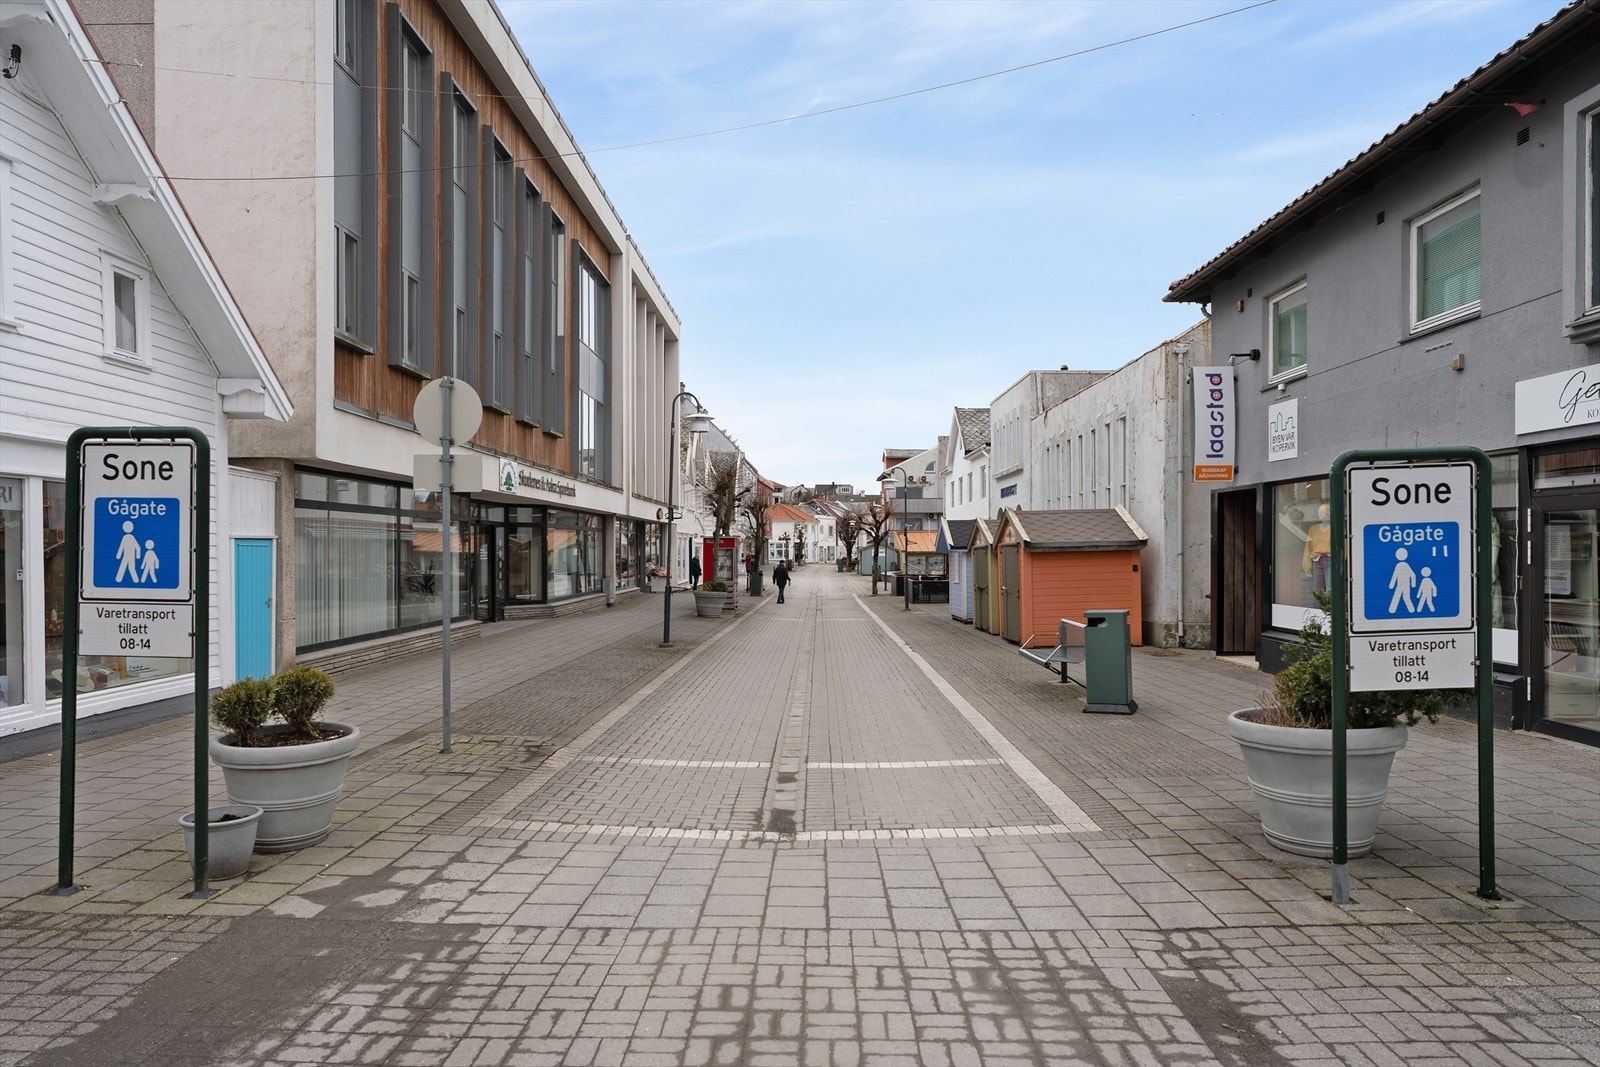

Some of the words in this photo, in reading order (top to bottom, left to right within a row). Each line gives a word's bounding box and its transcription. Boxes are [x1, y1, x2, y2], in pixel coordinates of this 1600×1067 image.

[1559, 370, 1600, 423] Ge
[1205, 373, 1224, 458] laastad
[1587, 408, 1600, 419] KO
[1272, 434, 1285, 444] BYEN
[1272, 441, 1296, 453] KOPERVIK
[102, 453, 174, 481] Sone
[1370, 477, 1452, 506] Sone
[108, 499, 167, 519] Gågate
[1378, 525, 1444, 546] Gågate
[96, 607, 176, 621] Varetransport
[118, 623, 148, 635] tillatt
[119, 638, 151, 650] 08-14
[1368, 638, 1456, 653] Varetransport
[1393, 655, 1426, 668] tillatt
[1395, 671, 1429, 683] 08-14
